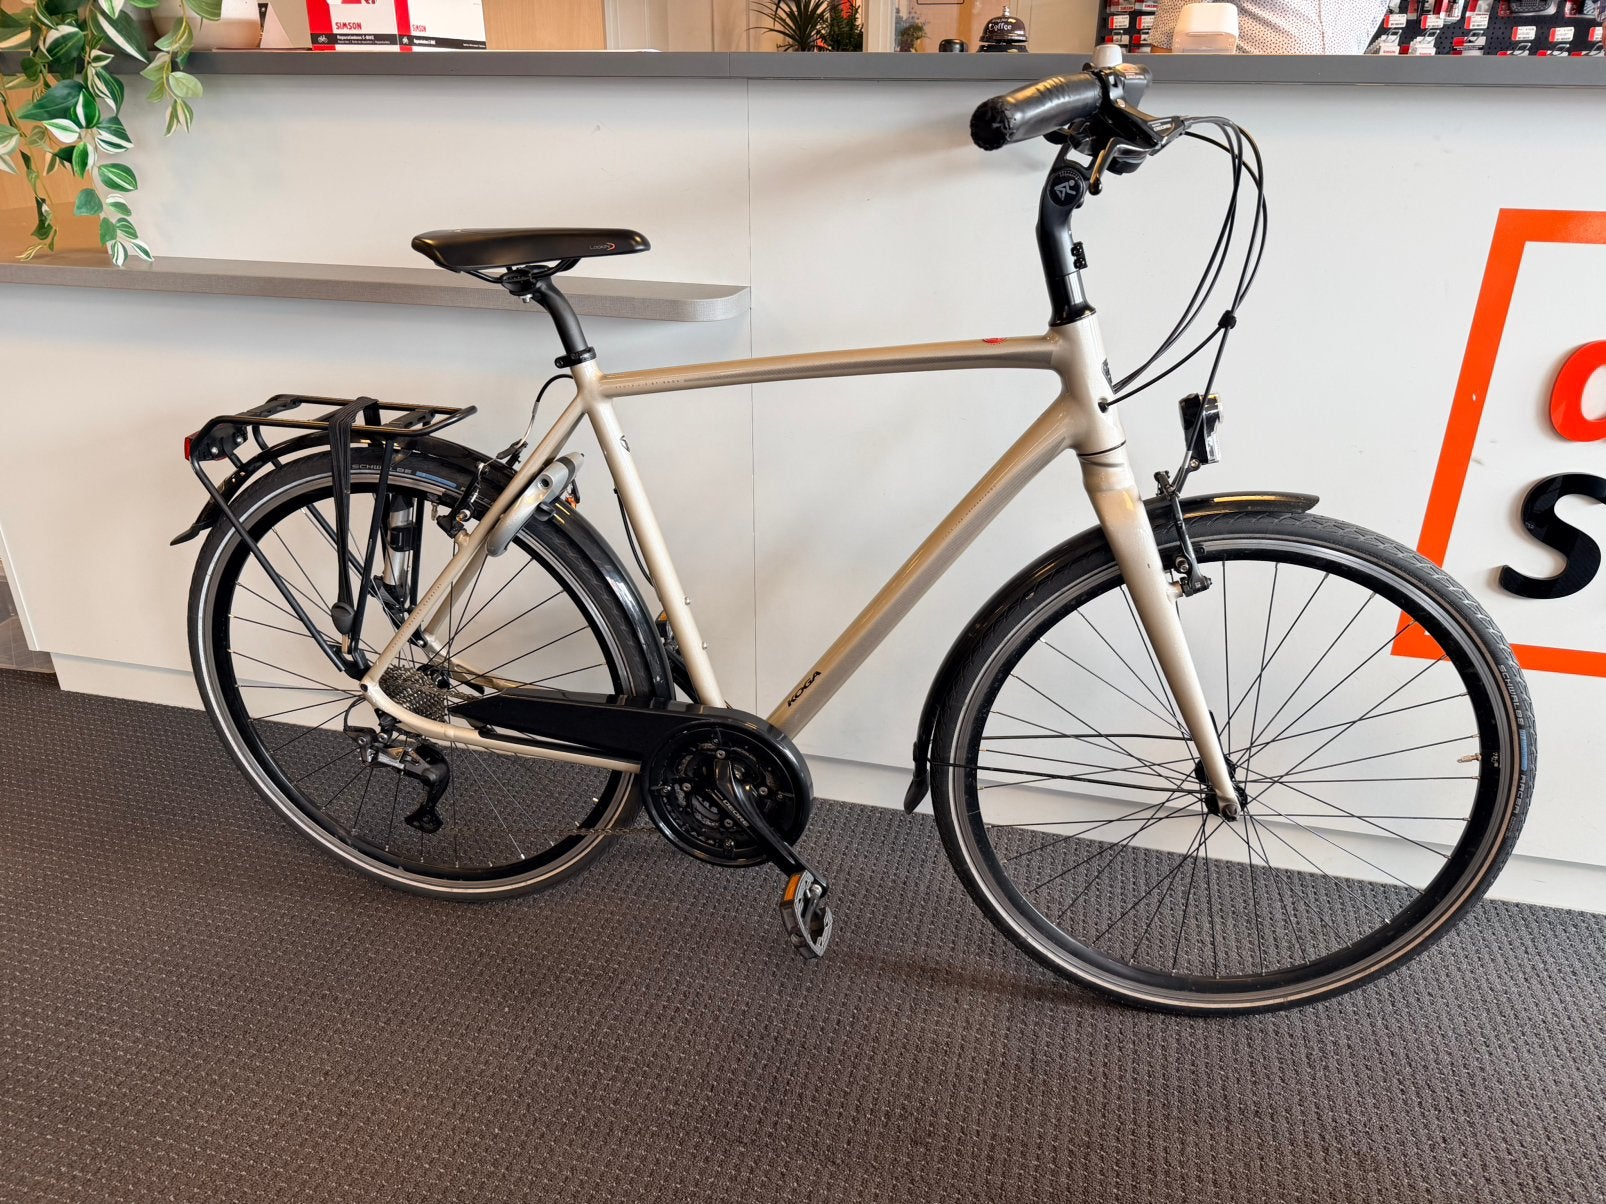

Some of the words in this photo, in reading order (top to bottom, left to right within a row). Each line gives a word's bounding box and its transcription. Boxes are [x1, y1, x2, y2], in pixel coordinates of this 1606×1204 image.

[335, 22, 362, 30] SIMSON
[988, 22, 1012, 31] Coffee
[351, 464, 413, 474] SCHWLBE
[787, 671, 821, 707] KOGA
[1498, 664, 1525, 725] SCHWALBE
[722, 799, 749, 827] DEORE
